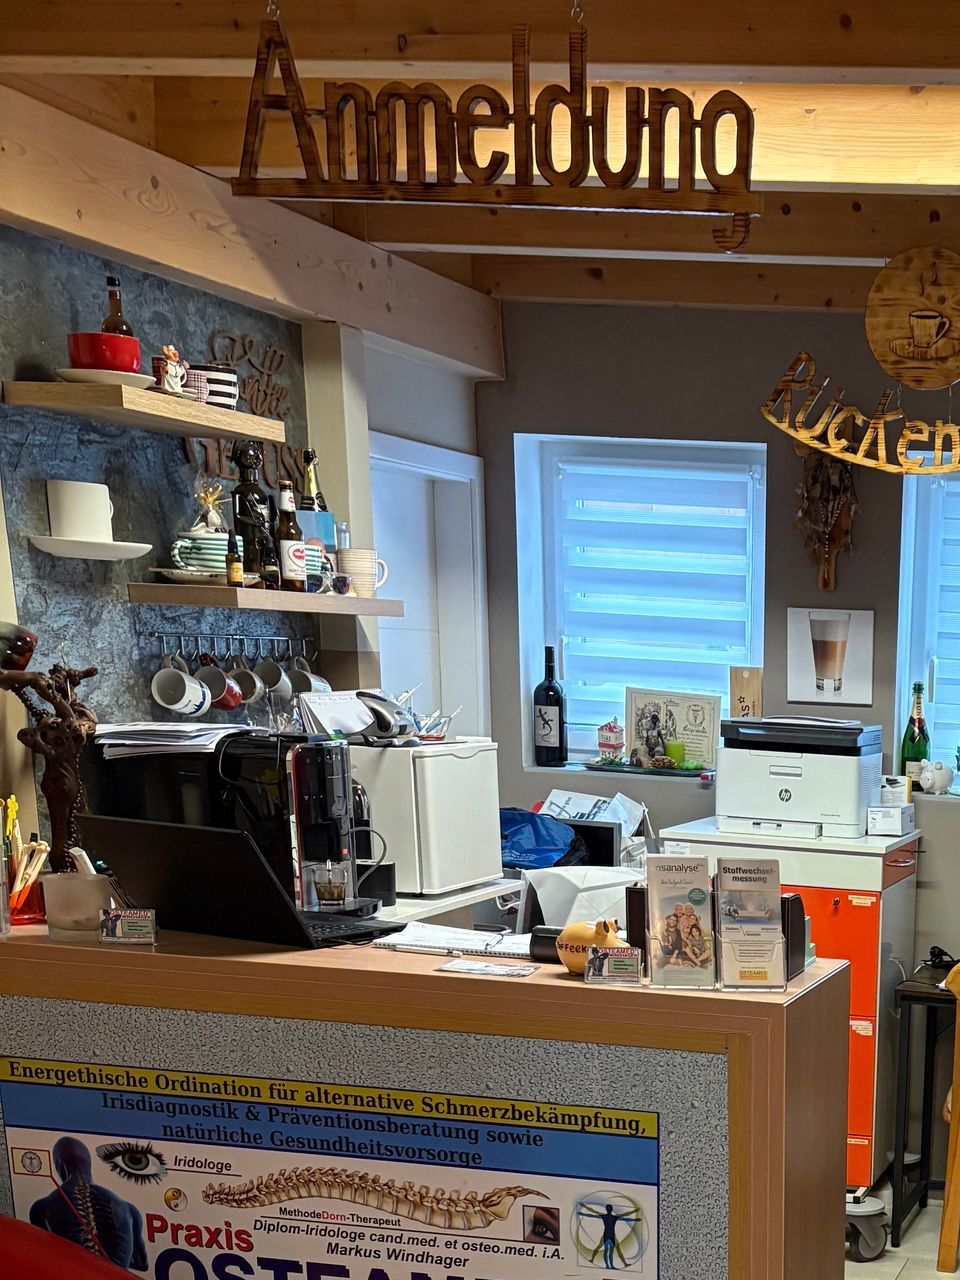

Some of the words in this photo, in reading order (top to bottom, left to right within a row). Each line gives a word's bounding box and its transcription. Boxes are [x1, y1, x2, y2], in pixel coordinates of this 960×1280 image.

[722, 866, 776, 876] Stoffwechsel-
[732, 876, 767, 884] messung
[9, 1061, 148, 1087] Energethische
[155, 1073, 262, 1099] Ordination
[268, 1083, 297, 1101] für
[305, 1086, 415, 1112] alternative
[422, 1098, 647, 1135] Schmerzbekämpfung,
[101, 1091, 239, 1121] Irisdiagnostik
[245, 1105, 260, 1121] &
[267, 1106, 479, 1145] Präventionsberatung
[486, 1129, 544, 1147] sowie
[162, 1122, 263, 1146] natürliche
[269, 1130, 482, 1167] Gesundheitsvorsorge
[173, 1155, 232, 1172] Iridologe
[146, 1213, 254, 1252] Praxis
[278, 1206, 401, 1228] MethodeDorn-Therapeut
[253, 1219, 365, 1243] Diplom-Iridologe
[369, 1231, 440, 1250] cand.med.
[444, 1237, 458, 1250] et
[462, 1240, 538, 1259] osteo.med.
[542, 1245, 565, 1261] i.A.
[326, 1243, 381, 1261] Markus
[386, 1248, 469, 1268] Windhager
